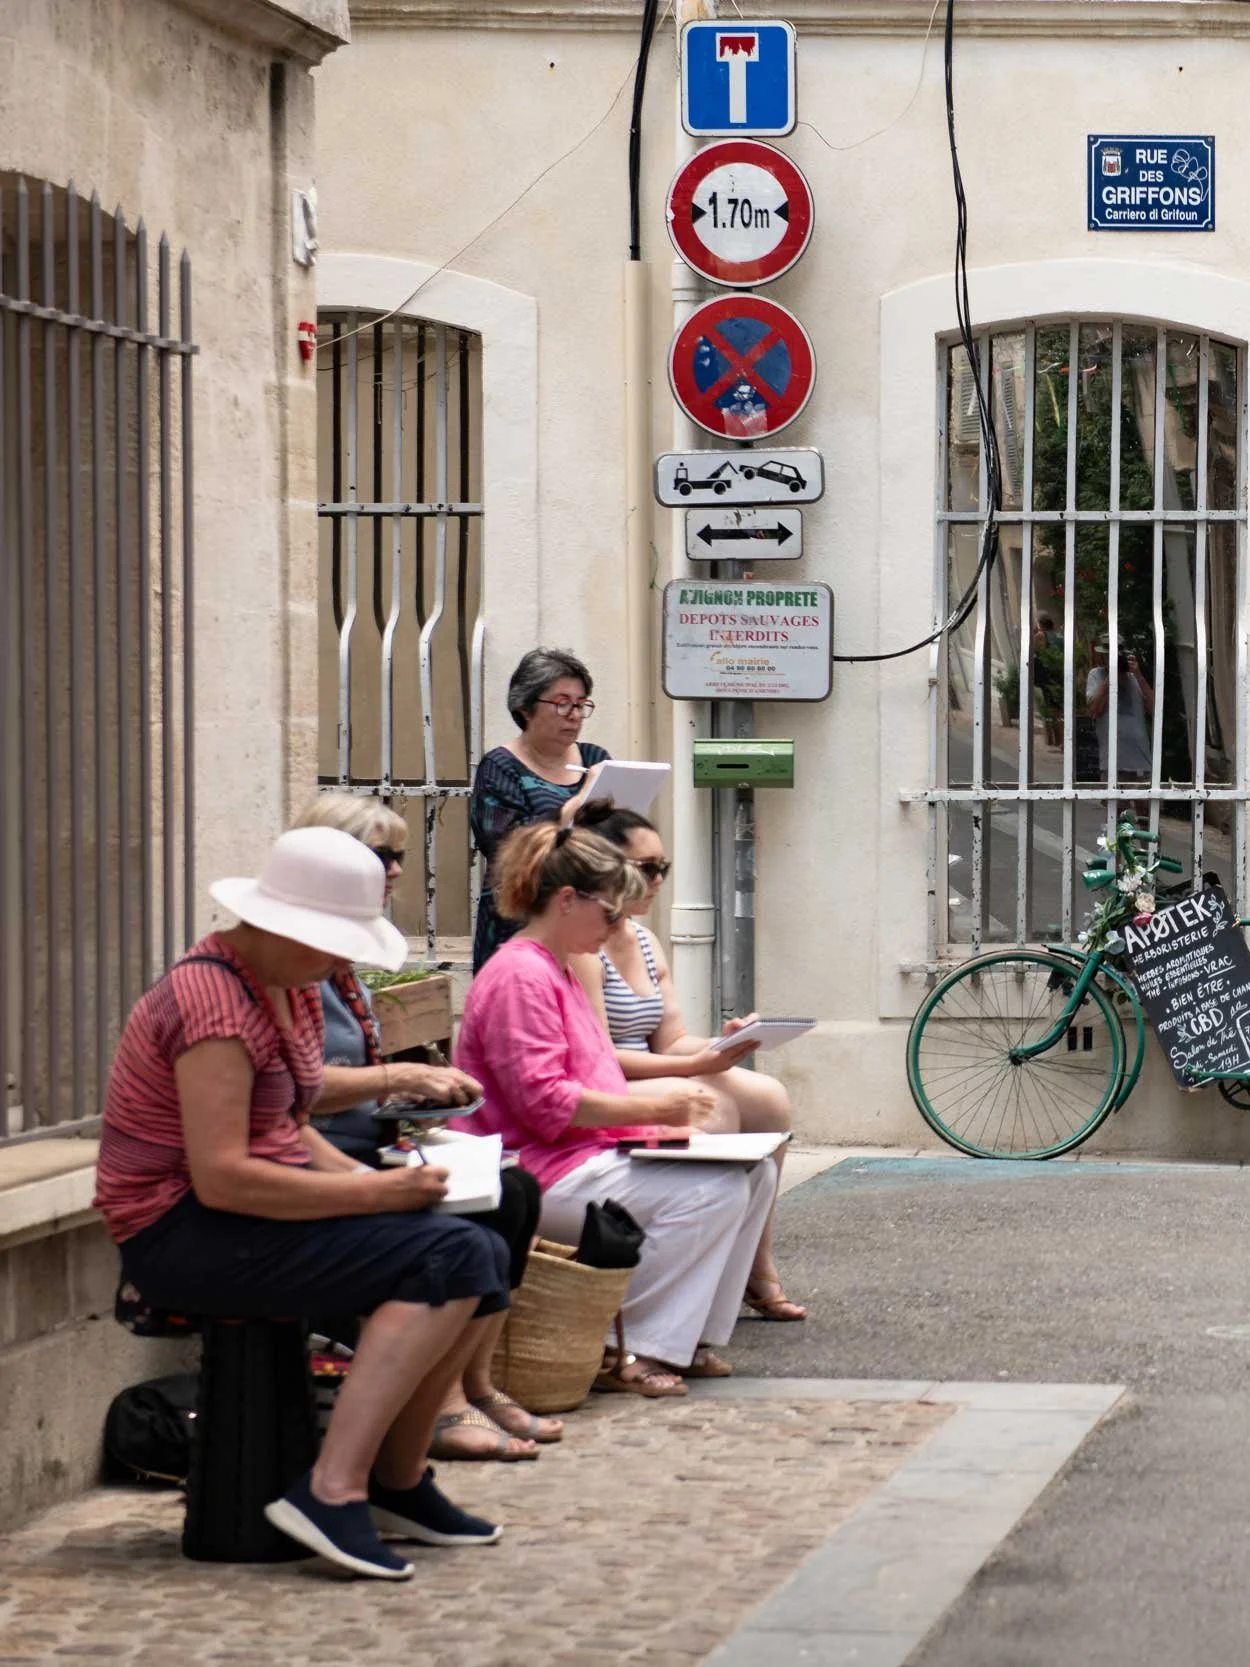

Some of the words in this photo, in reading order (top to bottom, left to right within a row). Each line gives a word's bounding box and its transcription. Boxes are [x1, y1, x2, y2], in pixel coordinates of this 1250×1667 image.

[1135, 148, 1168, 164] RUE
[1139, 170, 1164, 182] DES
[1101, 186, 1201, 206] GRIFFONS
[708, 191, 770, 229] 1.70m
[1105, 208, 1147, 220] Carriero
[1149, 208, 1158, 220] di
[1161, 208, 1198, 221] Grifoun
[746, 590, 818, 607] PROPRETE
[679, 613, 737, 626] DEPOTS
[740, 614, 820, 627] SAUVAGES
[709, 629, 790, 642] INTERDITS
[1132, 926, 1209, 966] HERBORISTERIE
[1203, 955, 1233, 975] VRAC
[1136, 964, 1165, 984] HERBES
[1219, 991, 1231, 1005] DE
[1190, 1007, 1225, 1036] CBD
[1206, 1034, 1218, 1048] de
